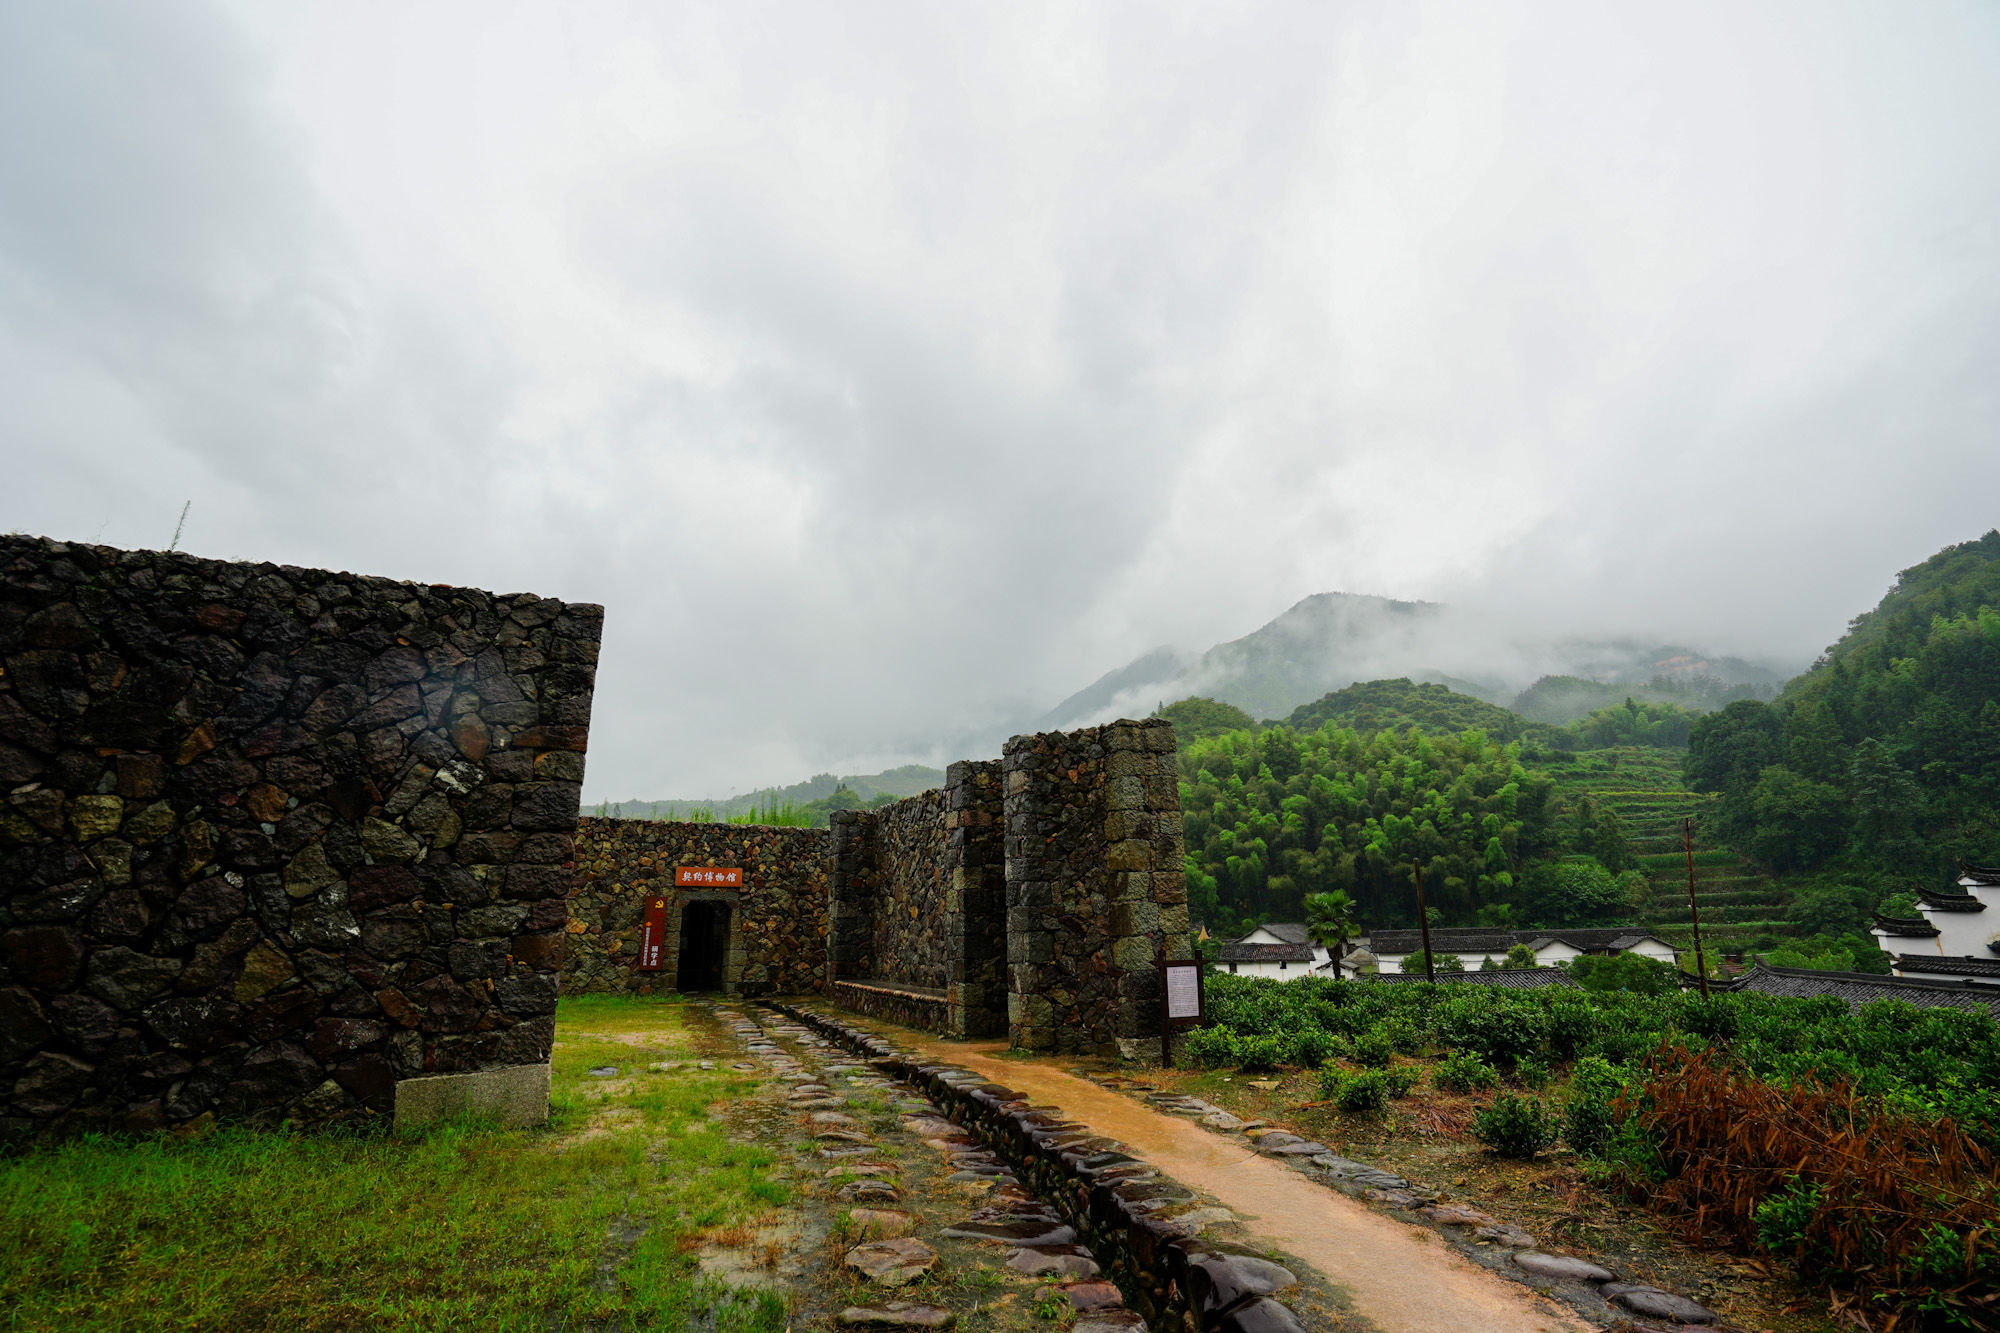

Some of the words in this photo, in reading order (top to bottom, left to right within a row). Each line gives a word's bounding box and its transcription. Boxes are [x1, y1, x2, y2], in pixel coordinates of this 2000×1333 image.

[682, 871, 737, 882] 契约博物馆
